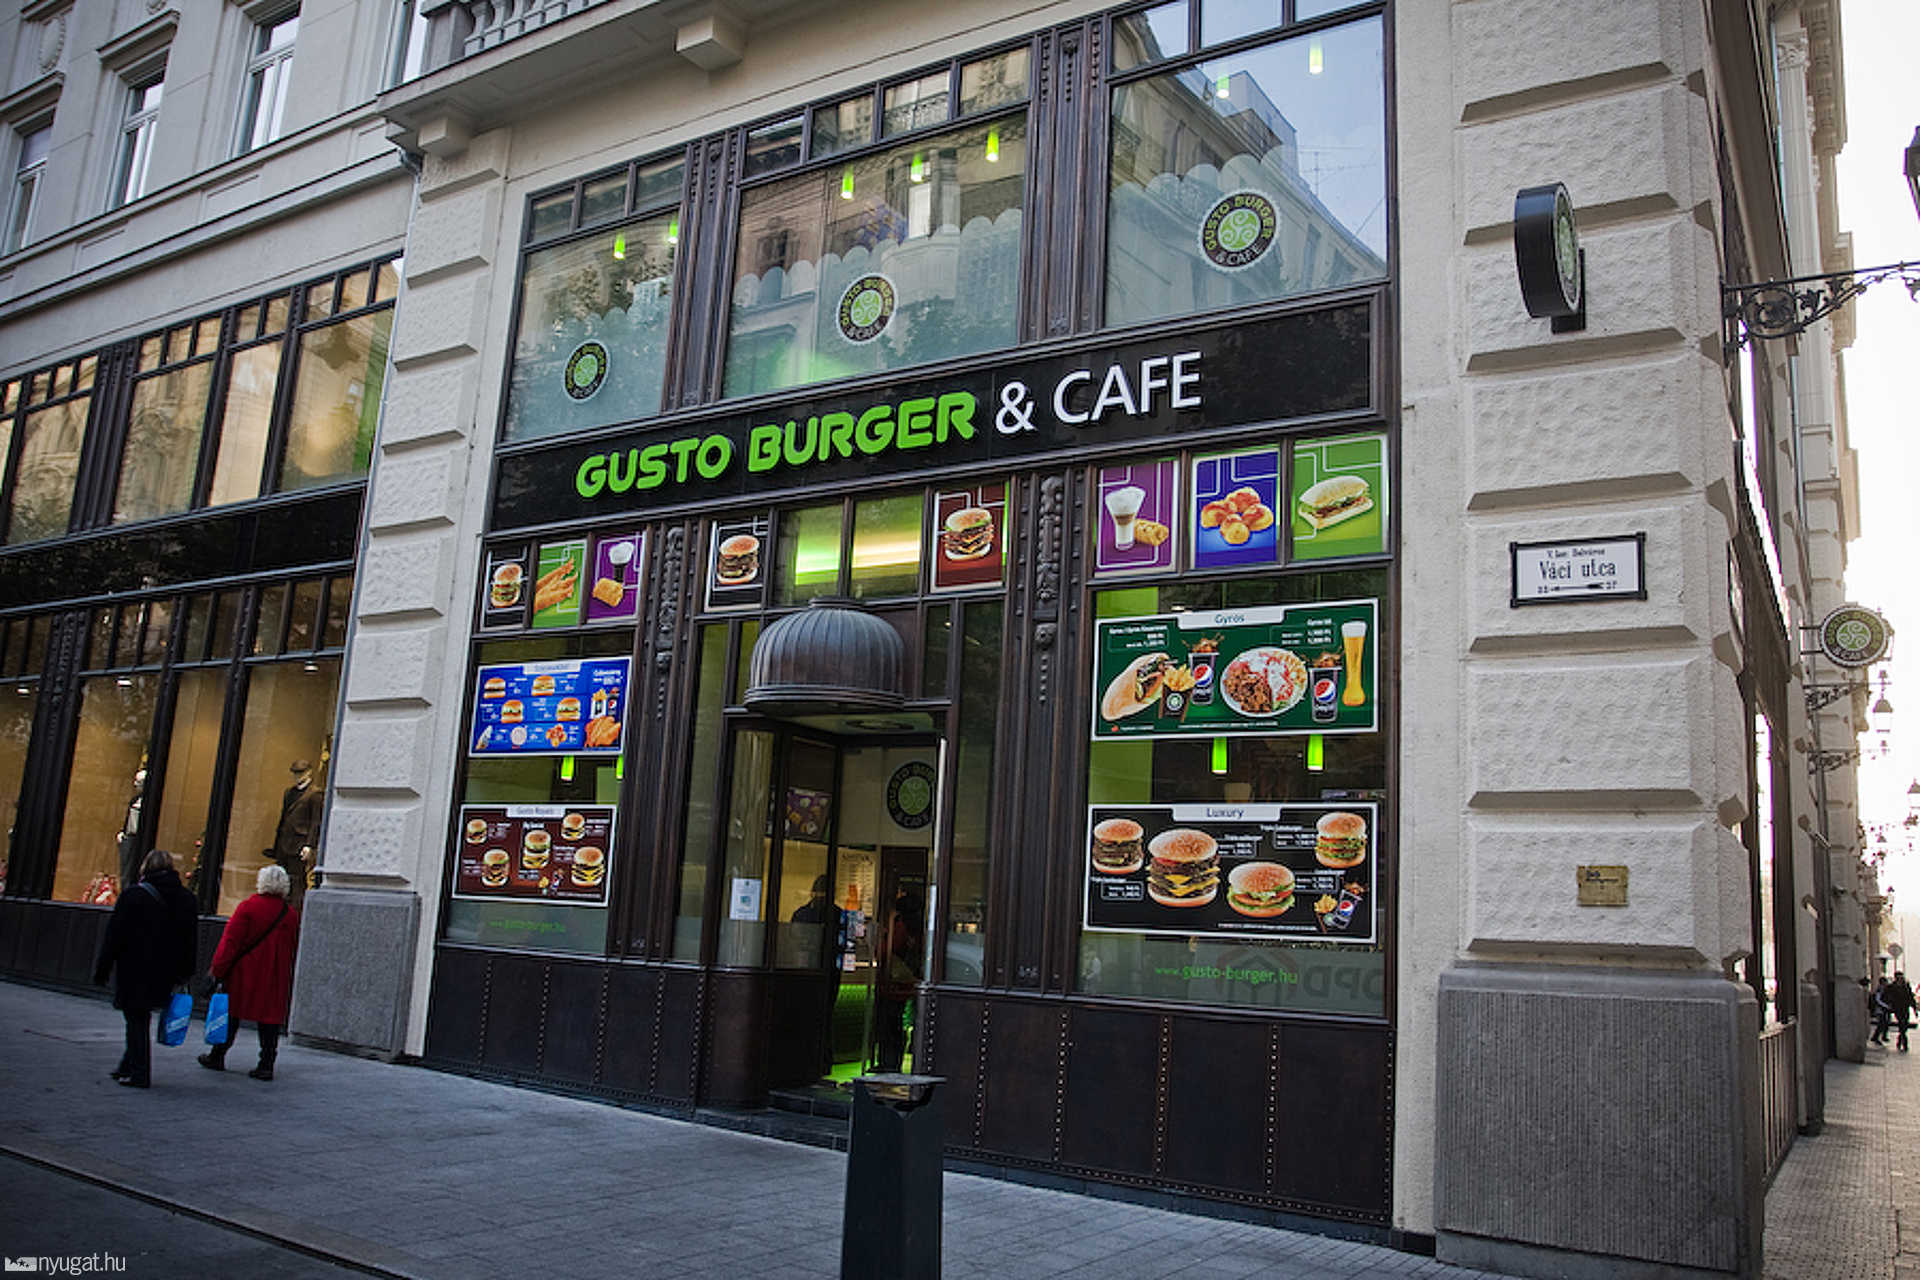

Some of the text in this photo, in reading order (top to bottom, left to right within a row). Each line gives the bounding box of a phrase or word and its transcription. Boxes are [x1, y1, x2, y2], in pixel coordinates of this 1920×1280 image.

[575, 351, 1203, 498] GUSTO BURGER & CAFE
[1538, 558, 1616, 579] Váci utca
[1215, 613, 1245, 625] Gyros
[1207, 807, 1245, 819] Luxury
[1155, 965, 1297, 984] www.gusto-burger.hu
